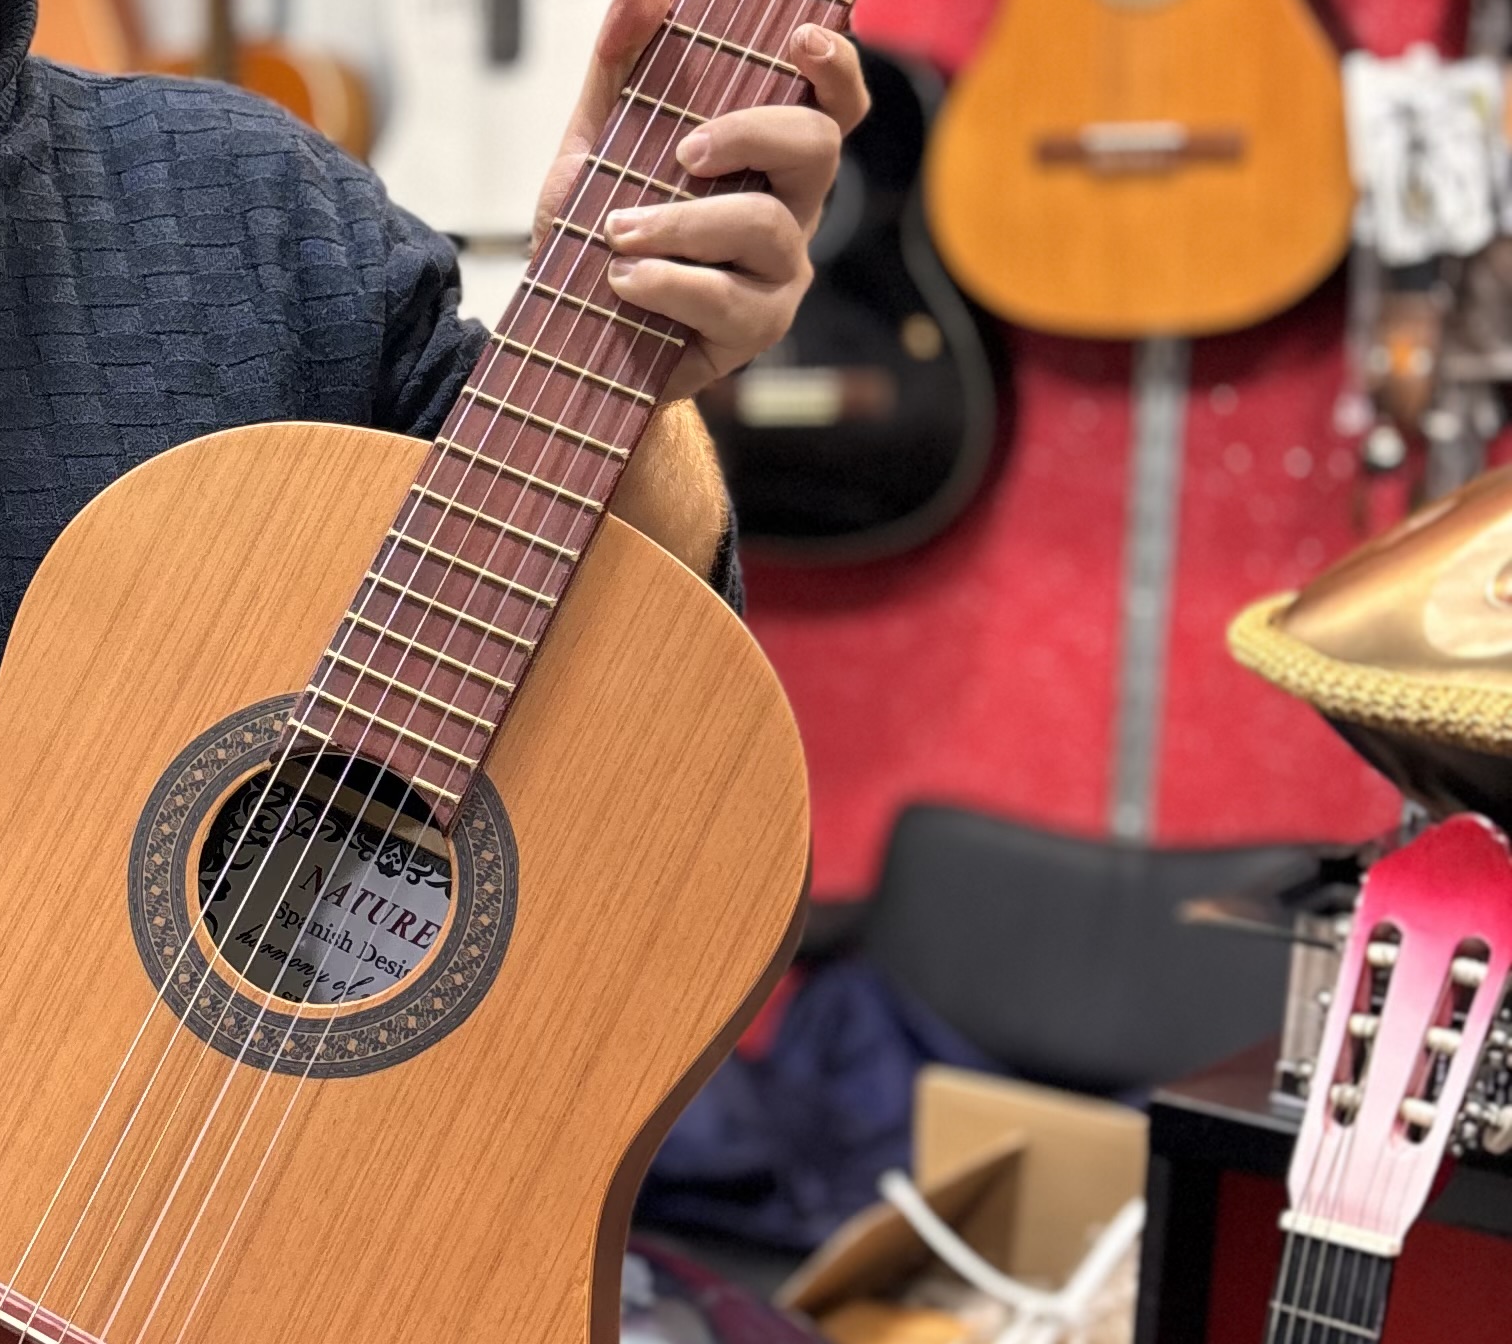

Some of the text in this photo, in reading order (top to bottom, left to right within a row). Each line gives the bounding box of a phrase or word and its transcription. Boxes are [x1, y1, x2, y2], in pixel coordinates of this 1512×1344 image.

[298, 864, 442, 950] NATURE
[235, 923, 375, 1002] harmony of
